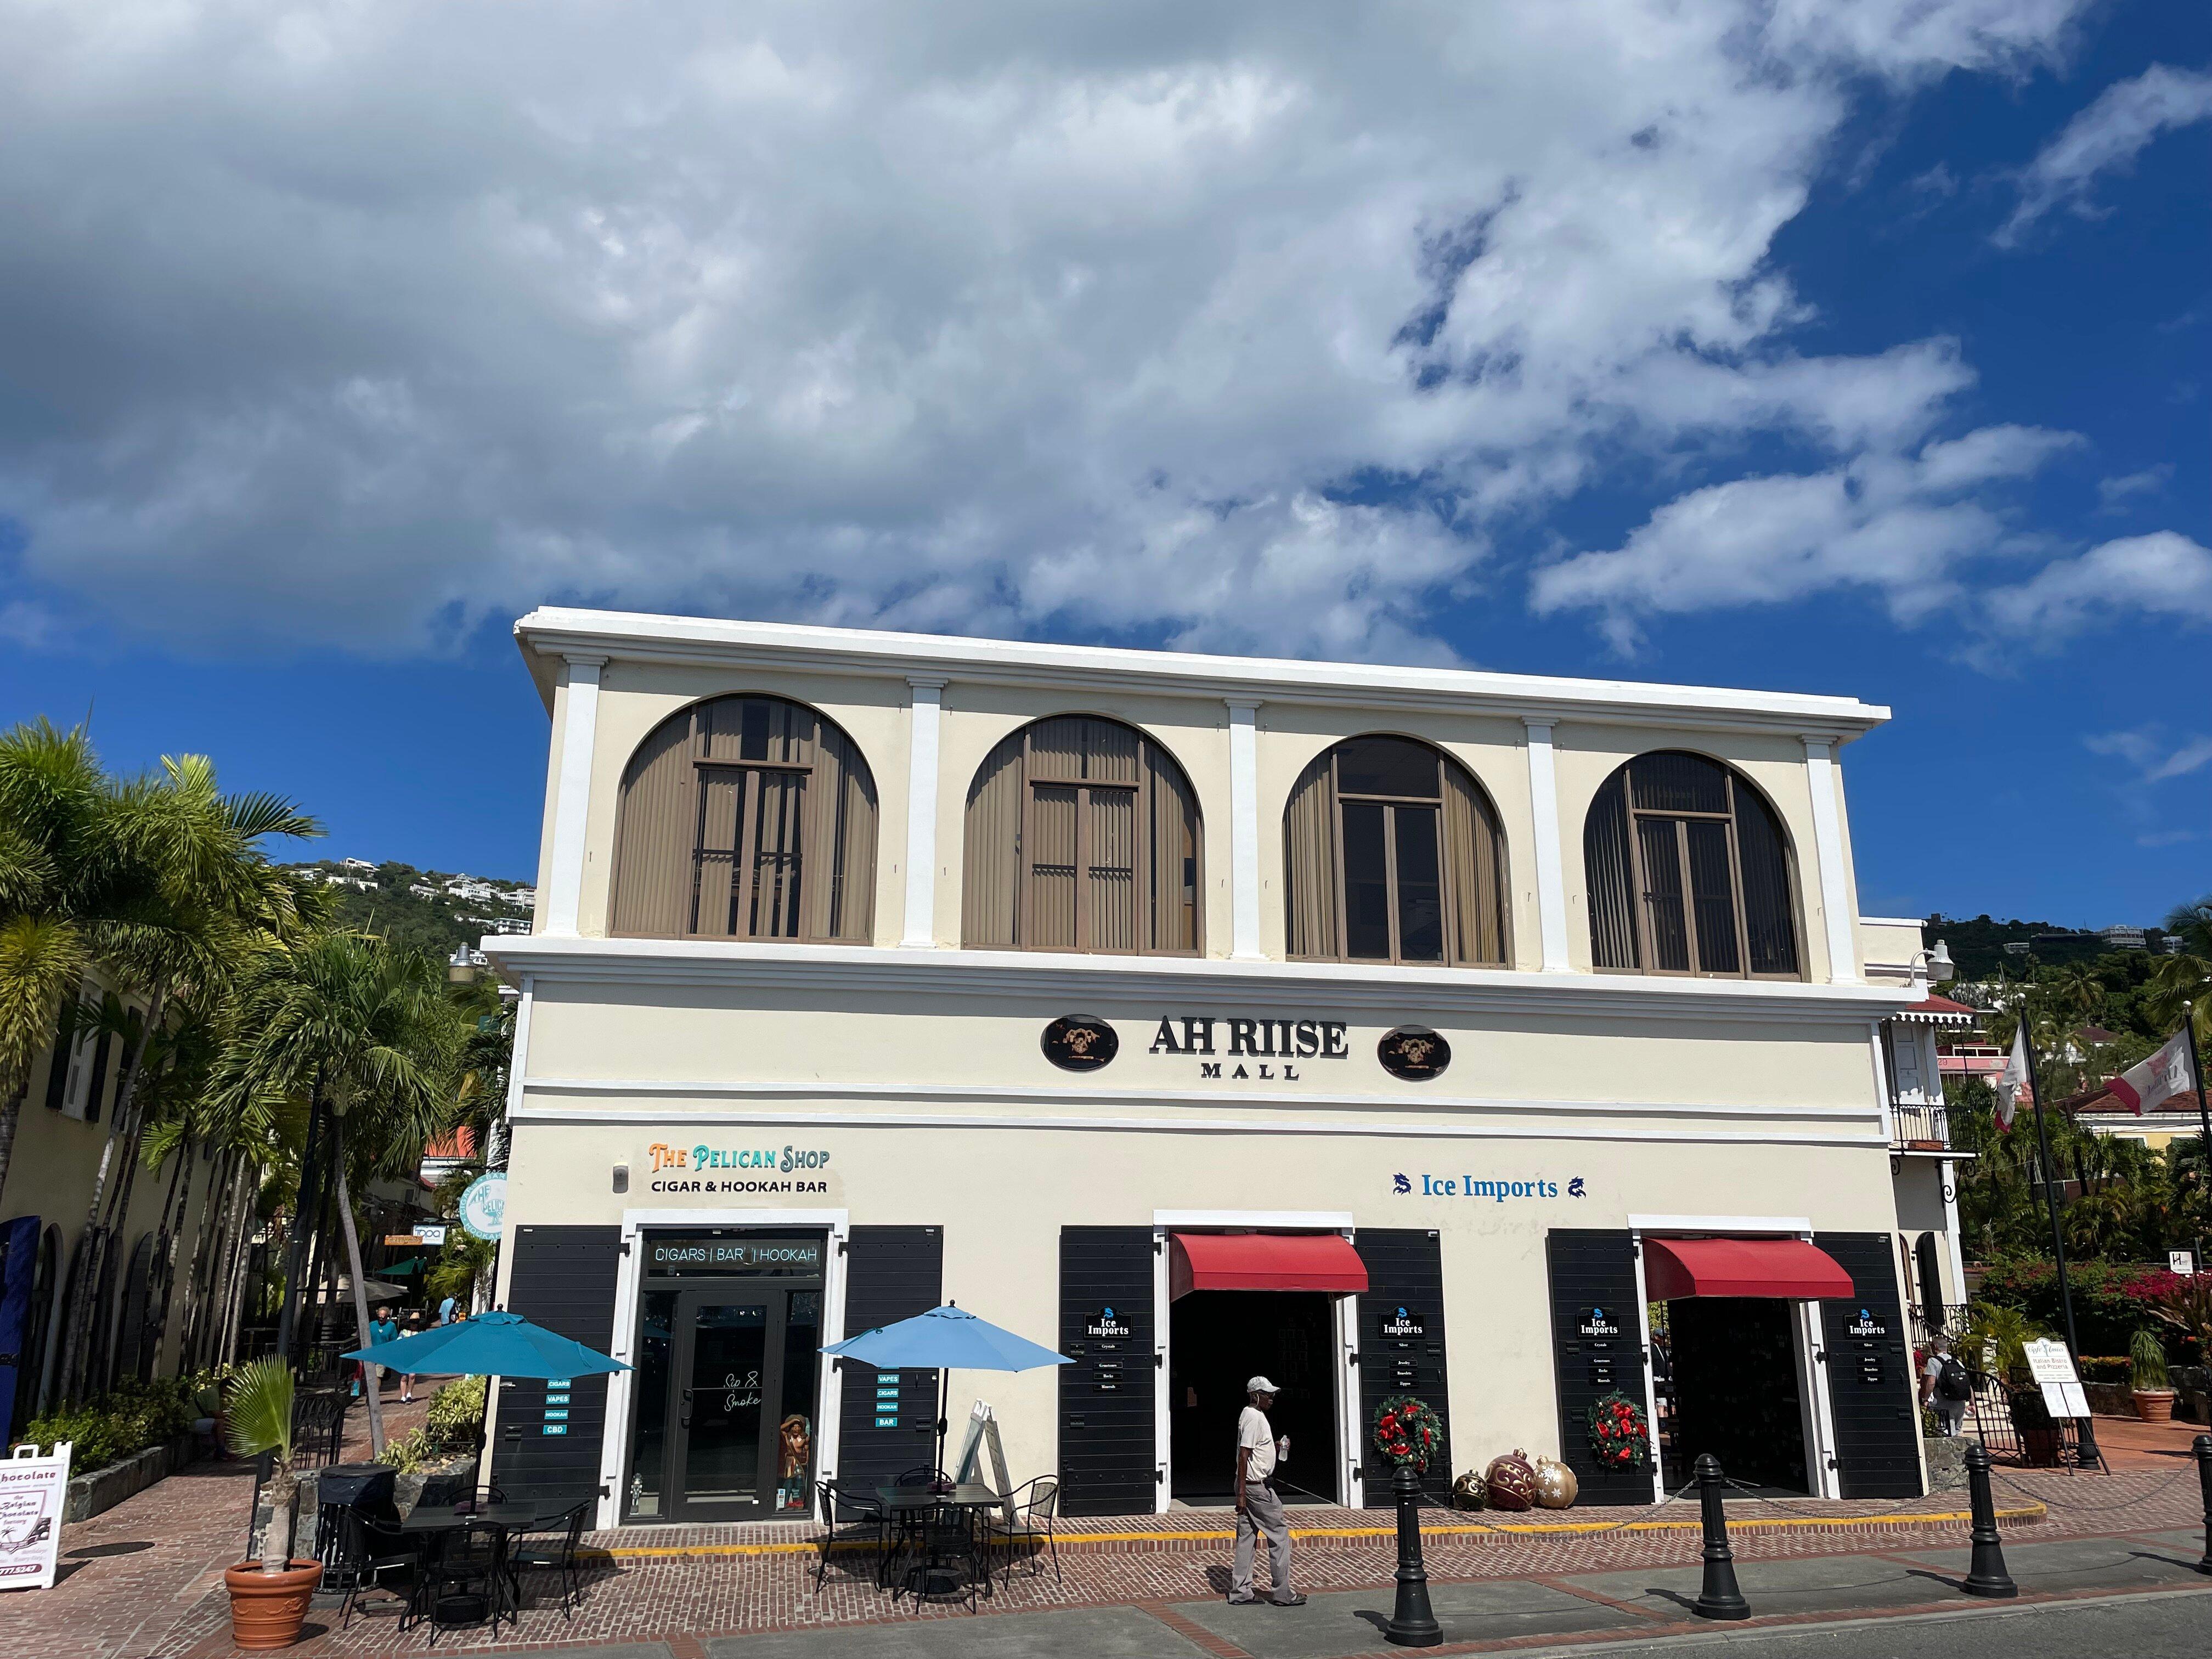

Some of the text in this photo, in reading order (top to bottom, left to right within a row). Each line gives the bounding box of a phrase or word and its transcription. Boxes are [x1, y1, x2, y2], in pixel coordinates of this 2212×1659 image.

[1149, 1015, 1348, 1059] AH RIISE
[1201, 1063, 1299, 1081] MALL
[651, 1181, 827, 1193] CIGAR & HOOKAH BAR
[1421, 1175, 1558, 1203] Ice Imports
[656, 1248, 816, 1261] CIGARS BAR HOOKAH
[1101, 1318, 1116, 1327] Ice
[1396, 1318, 1410, 1326] Ice
[1592, 1318, 1606, 1327] Ice
[1860, 1319, 1874, 1327] Ice
[1088, 1325, 1128, 1336] Imports
[1384, 1324, 1423, 1335] Imports
[1581, 1325, 1618, 1335] Imports
[1849, 1325, 1885, 1336] Imports
[724, 1371, 758, 1392] Sip &
[724, 1392, 761, 1412] Smoke
[0, 1471, 56, 1483] hocolate
